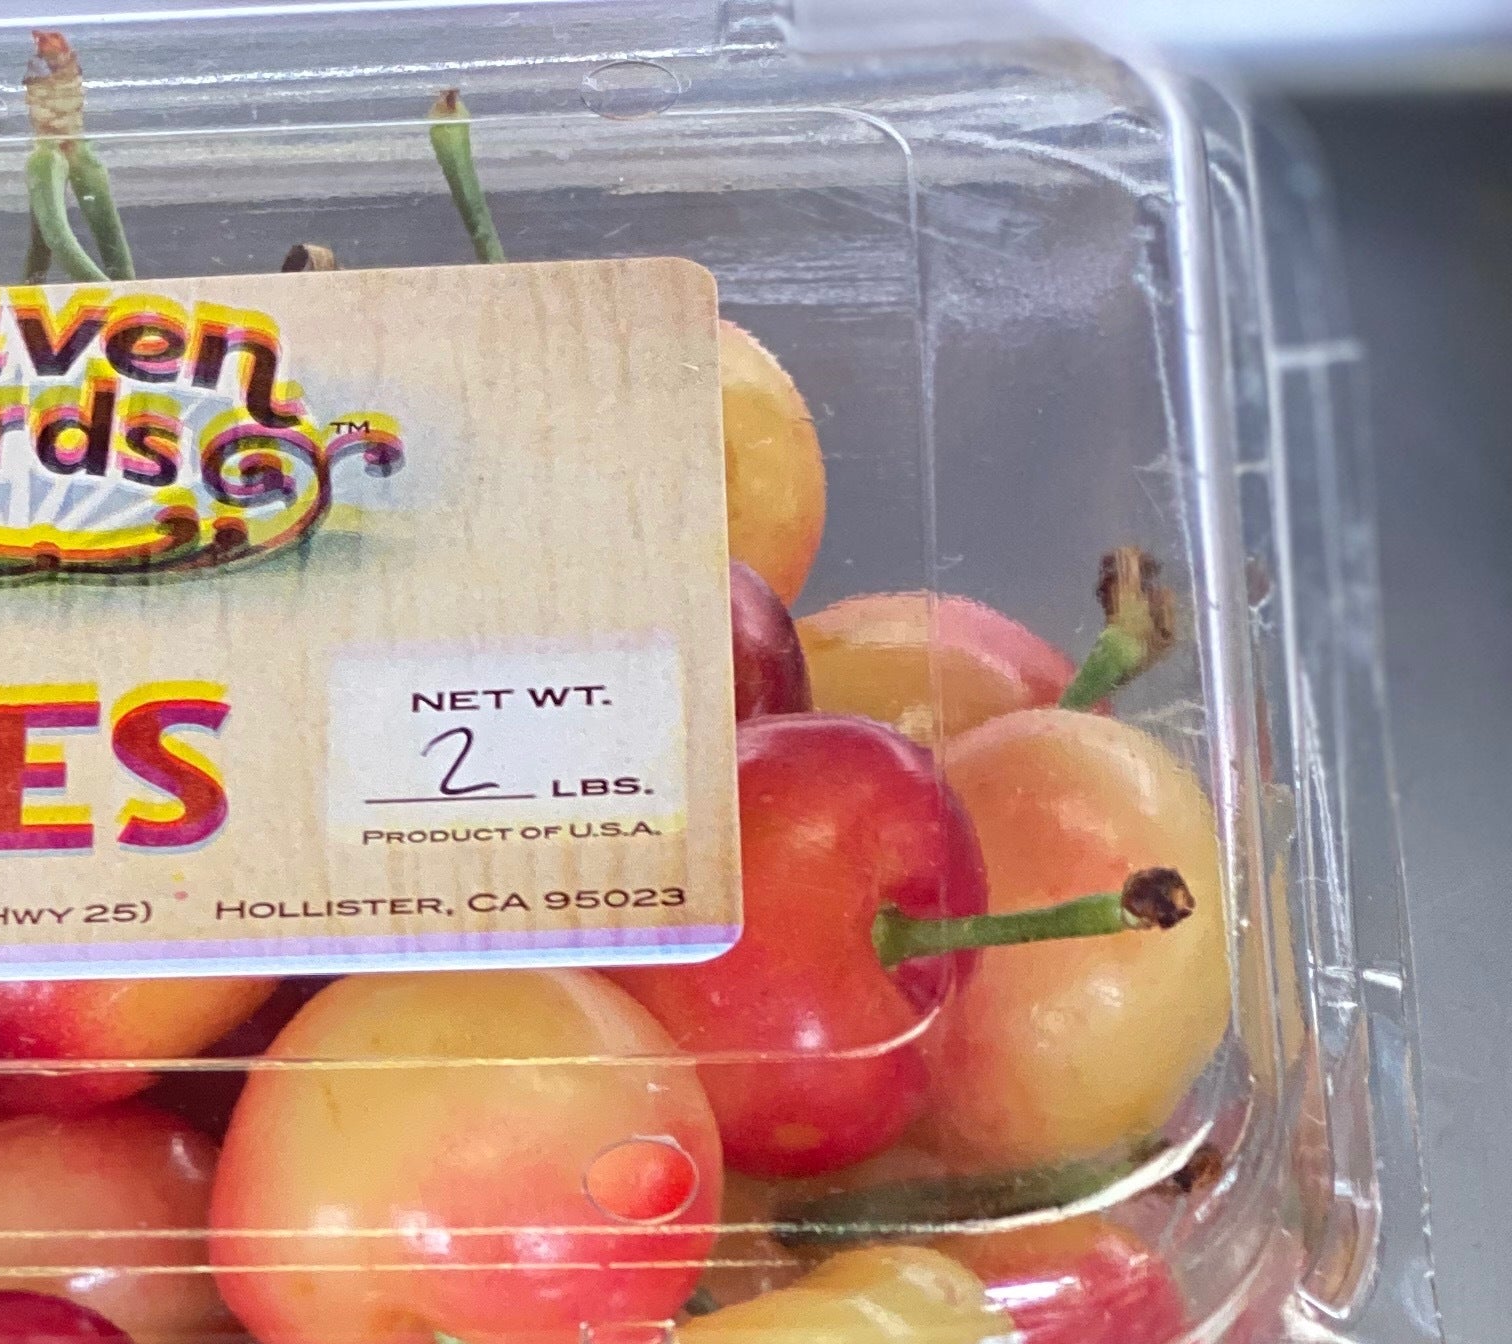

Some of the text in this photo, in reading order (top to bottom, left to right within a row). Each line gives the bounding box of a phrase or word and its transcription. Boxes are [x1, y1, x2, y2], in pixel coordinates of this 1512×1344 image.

[411, 685, 613, 713] NET WT.
[420, 726, 501, 796] 2
[551, 776, 655, 798] LBS.
[362, 822, 663, 846] PRODUCT OF U.S.A.
[82, 900, 153, 925] 25)
[215, 896, 455, 921] HOLLISTER,
[467, 891, 531, 914] CA
[544, 886, 687, 912] 95023
